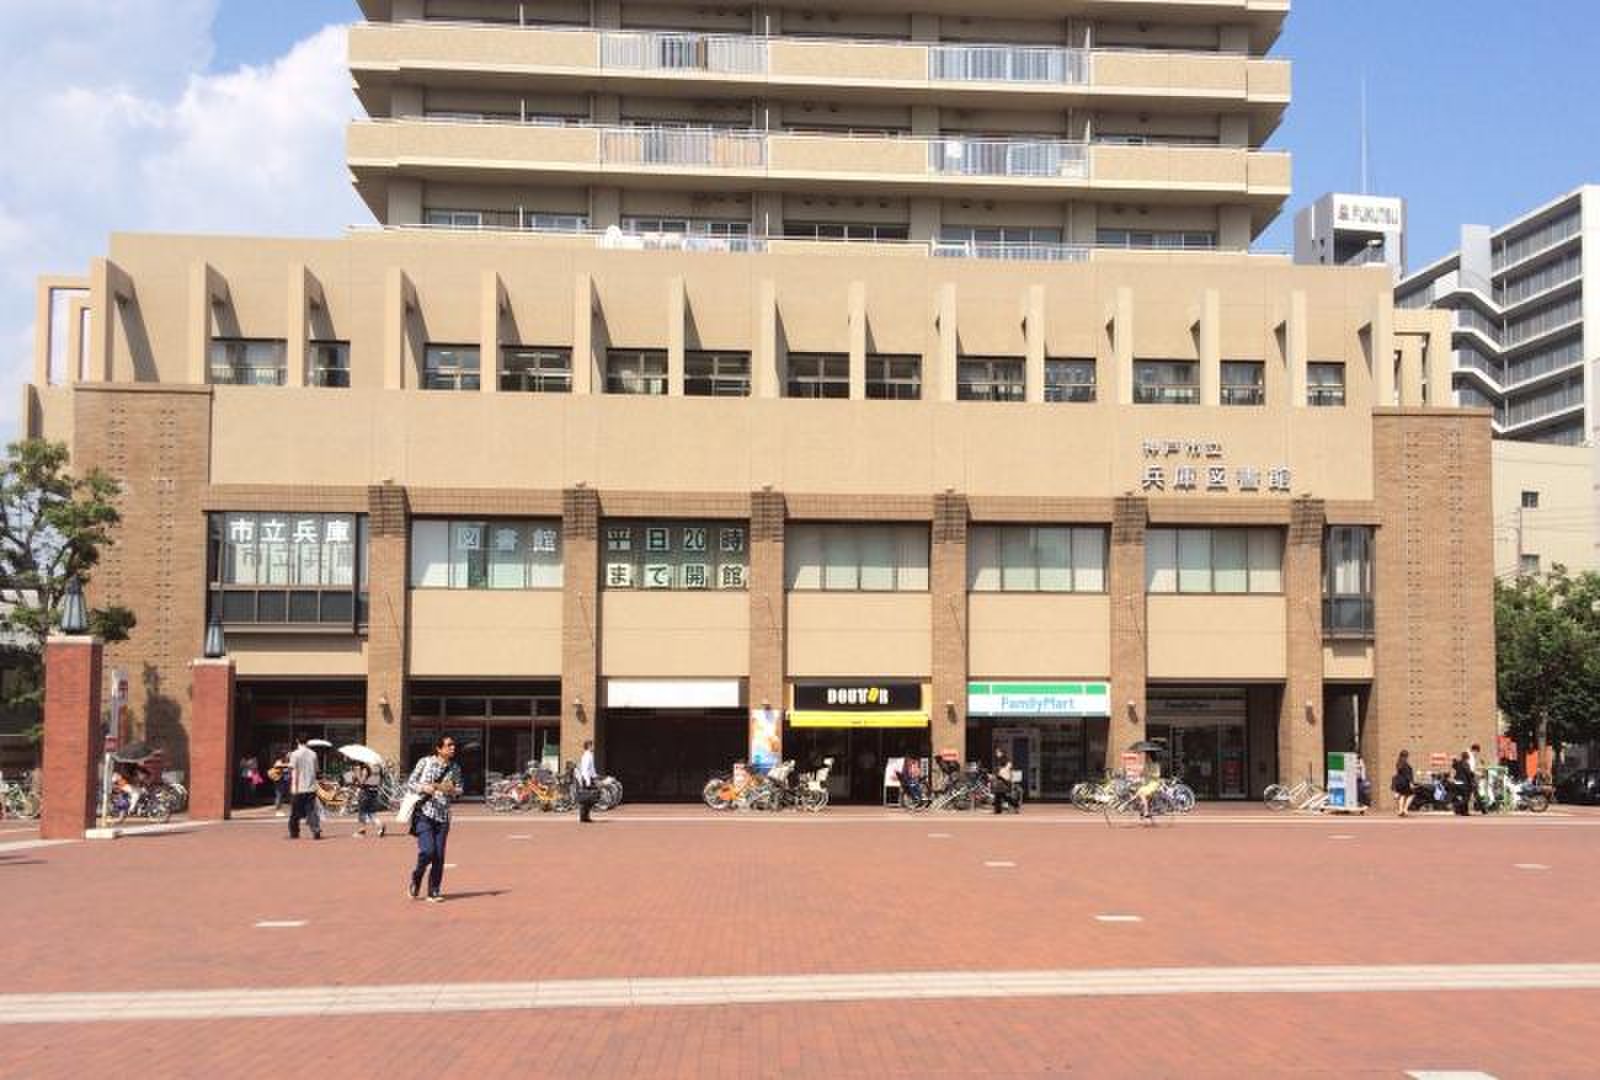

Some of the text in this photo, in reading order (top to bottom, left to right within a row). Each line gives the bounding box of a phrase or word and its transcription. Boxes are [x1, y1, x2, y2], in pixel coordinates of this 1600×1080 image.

[1141, 464, 1292, 492] 兵庫図書館
[229, 517, 351, 544] 市立兵庫
[609, 564, 744, 586] まで開館
[827, 687, 889, 705] DOUTOR
[1001, 696, 1075, 713] FamilyMart
